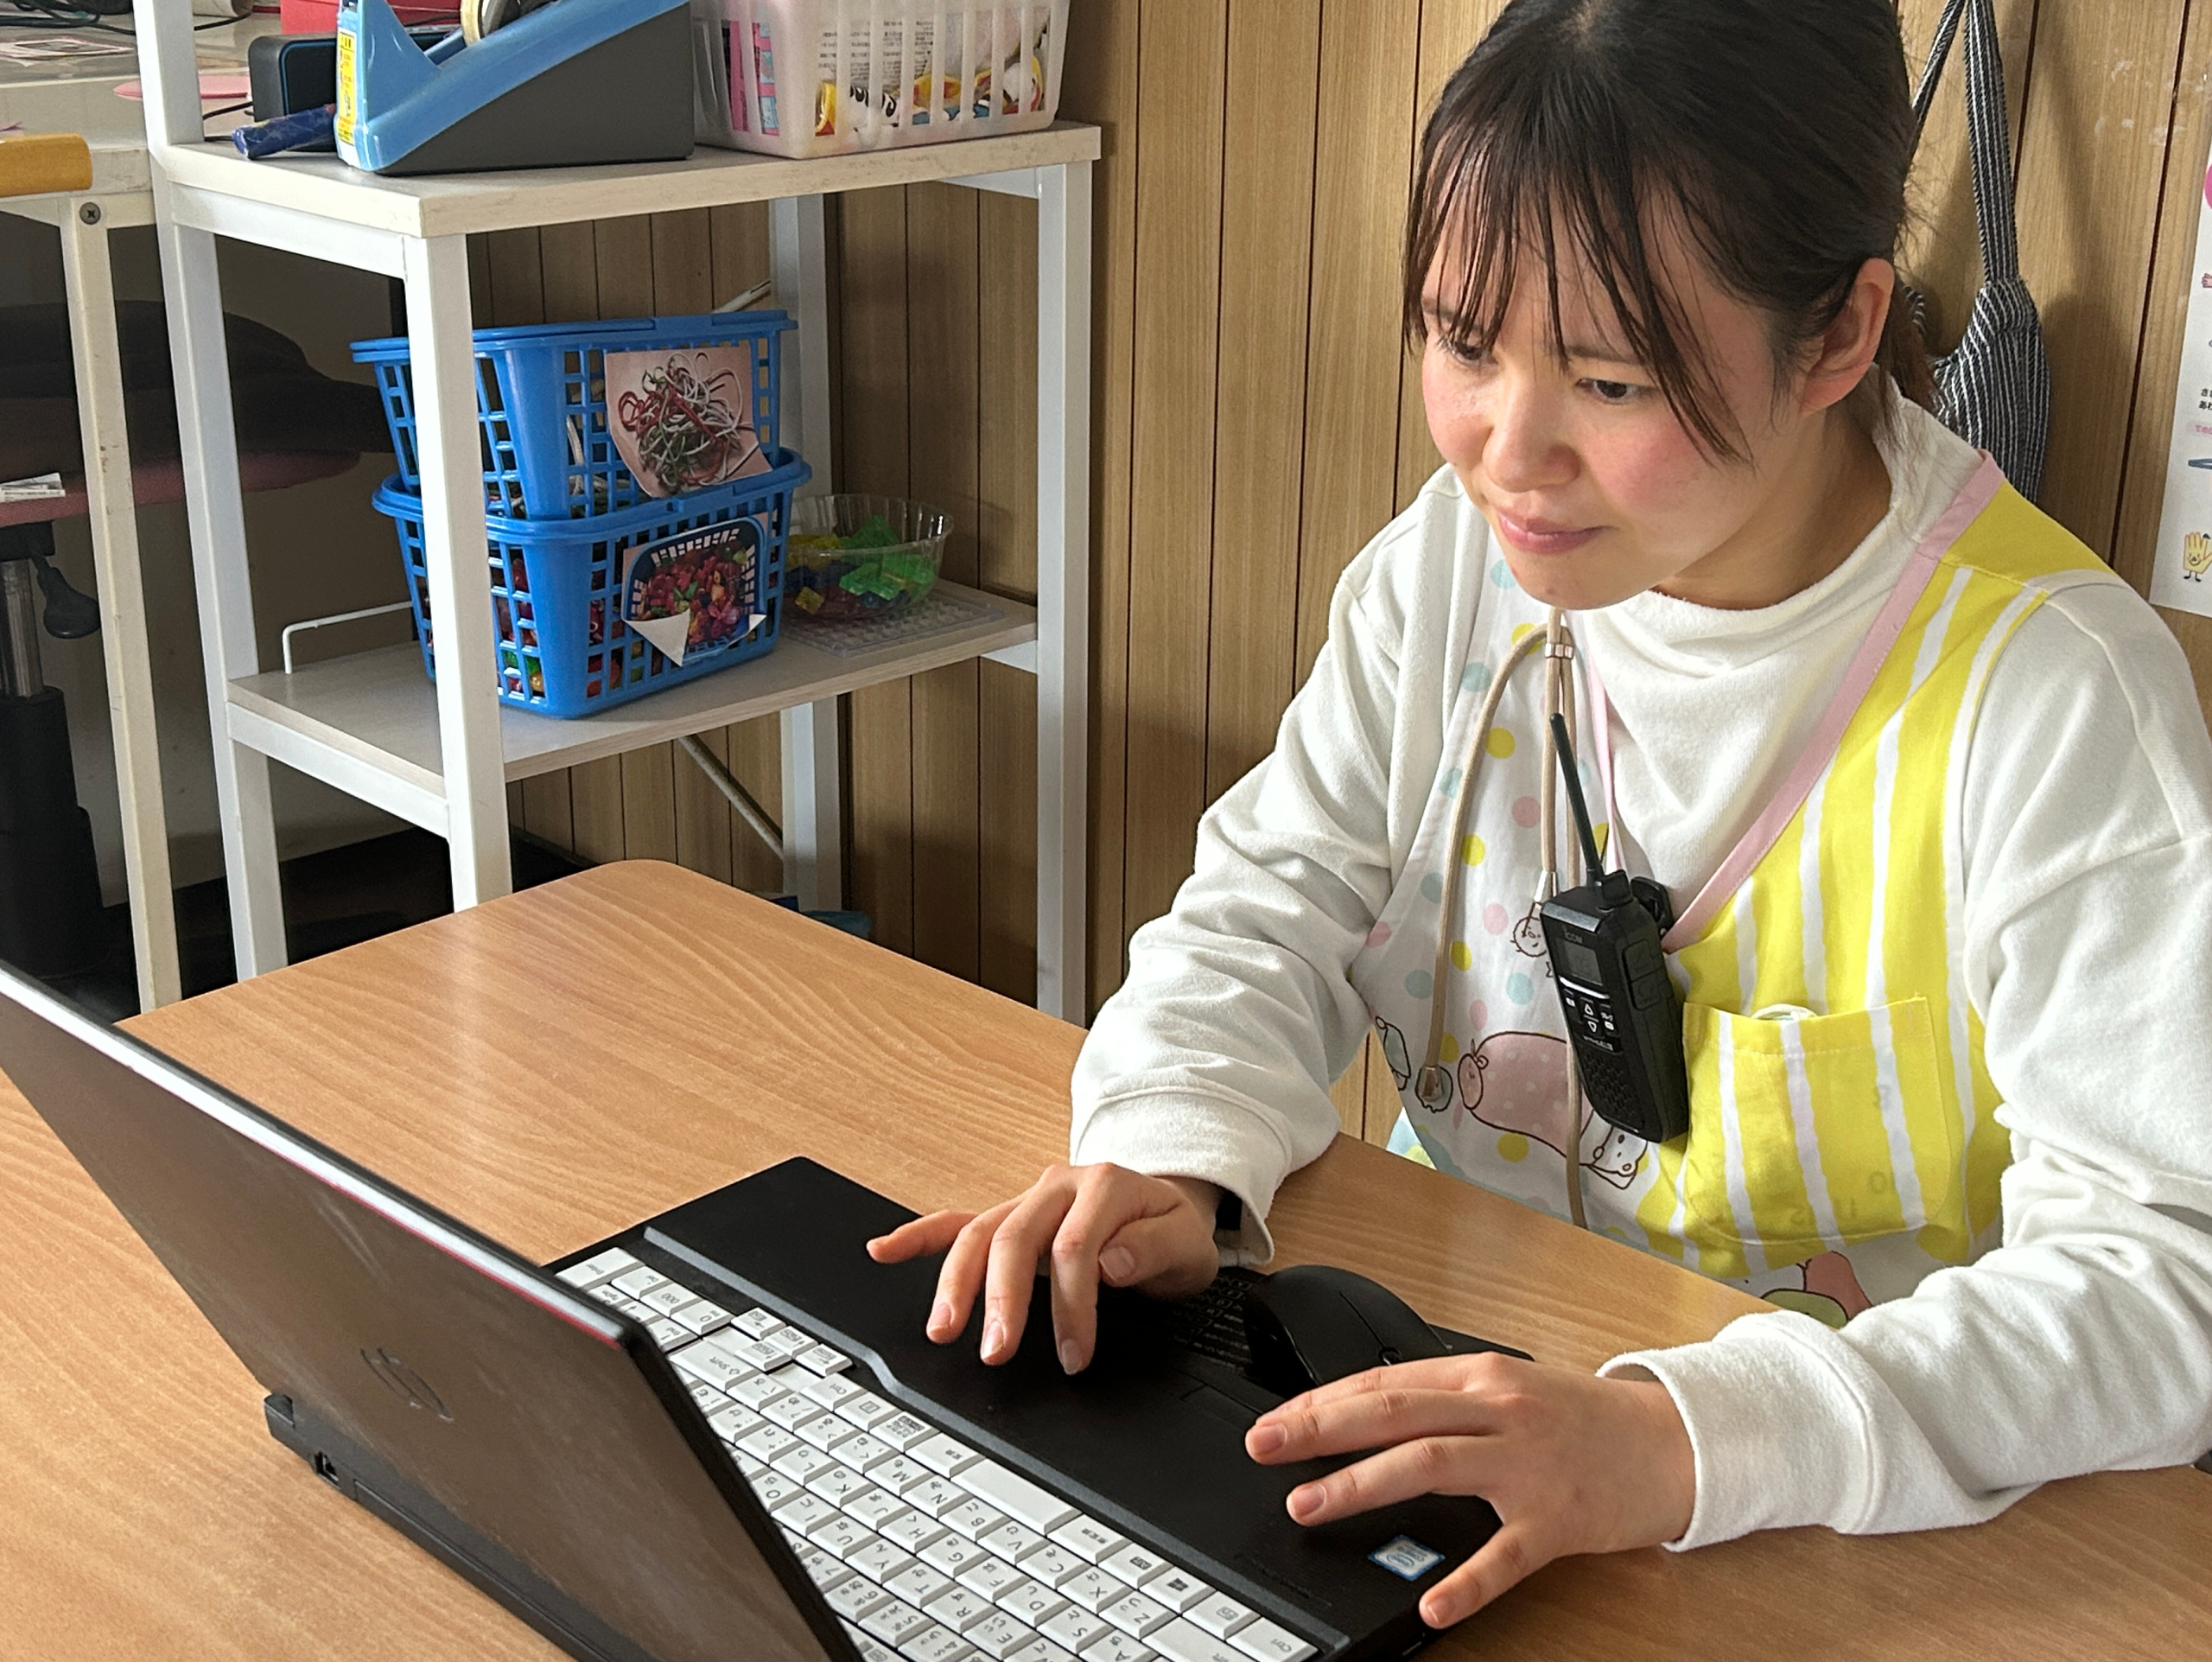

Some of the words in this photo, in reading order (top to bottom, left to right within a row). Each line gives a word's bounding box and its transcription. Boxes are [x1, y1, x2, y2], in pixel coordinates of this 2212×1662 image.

[891, 1470, 912, 1483] M
[834, 1483, 852, 1494] K
[930, 1493, 949, 1506] N
[908, 1527, 926, 1539] H
[1089, 1586, 1108, 1600] X
[956, 1606, 973, 1619] R
[1028, 1600, 1046, 1612] D
[1133, 1612, 1152, 1625] Z
[995, 1633, 1014, 1645] E
[1071, 1627, 1089, 1639] S
[1115, 1649, 1132, 1662] A
